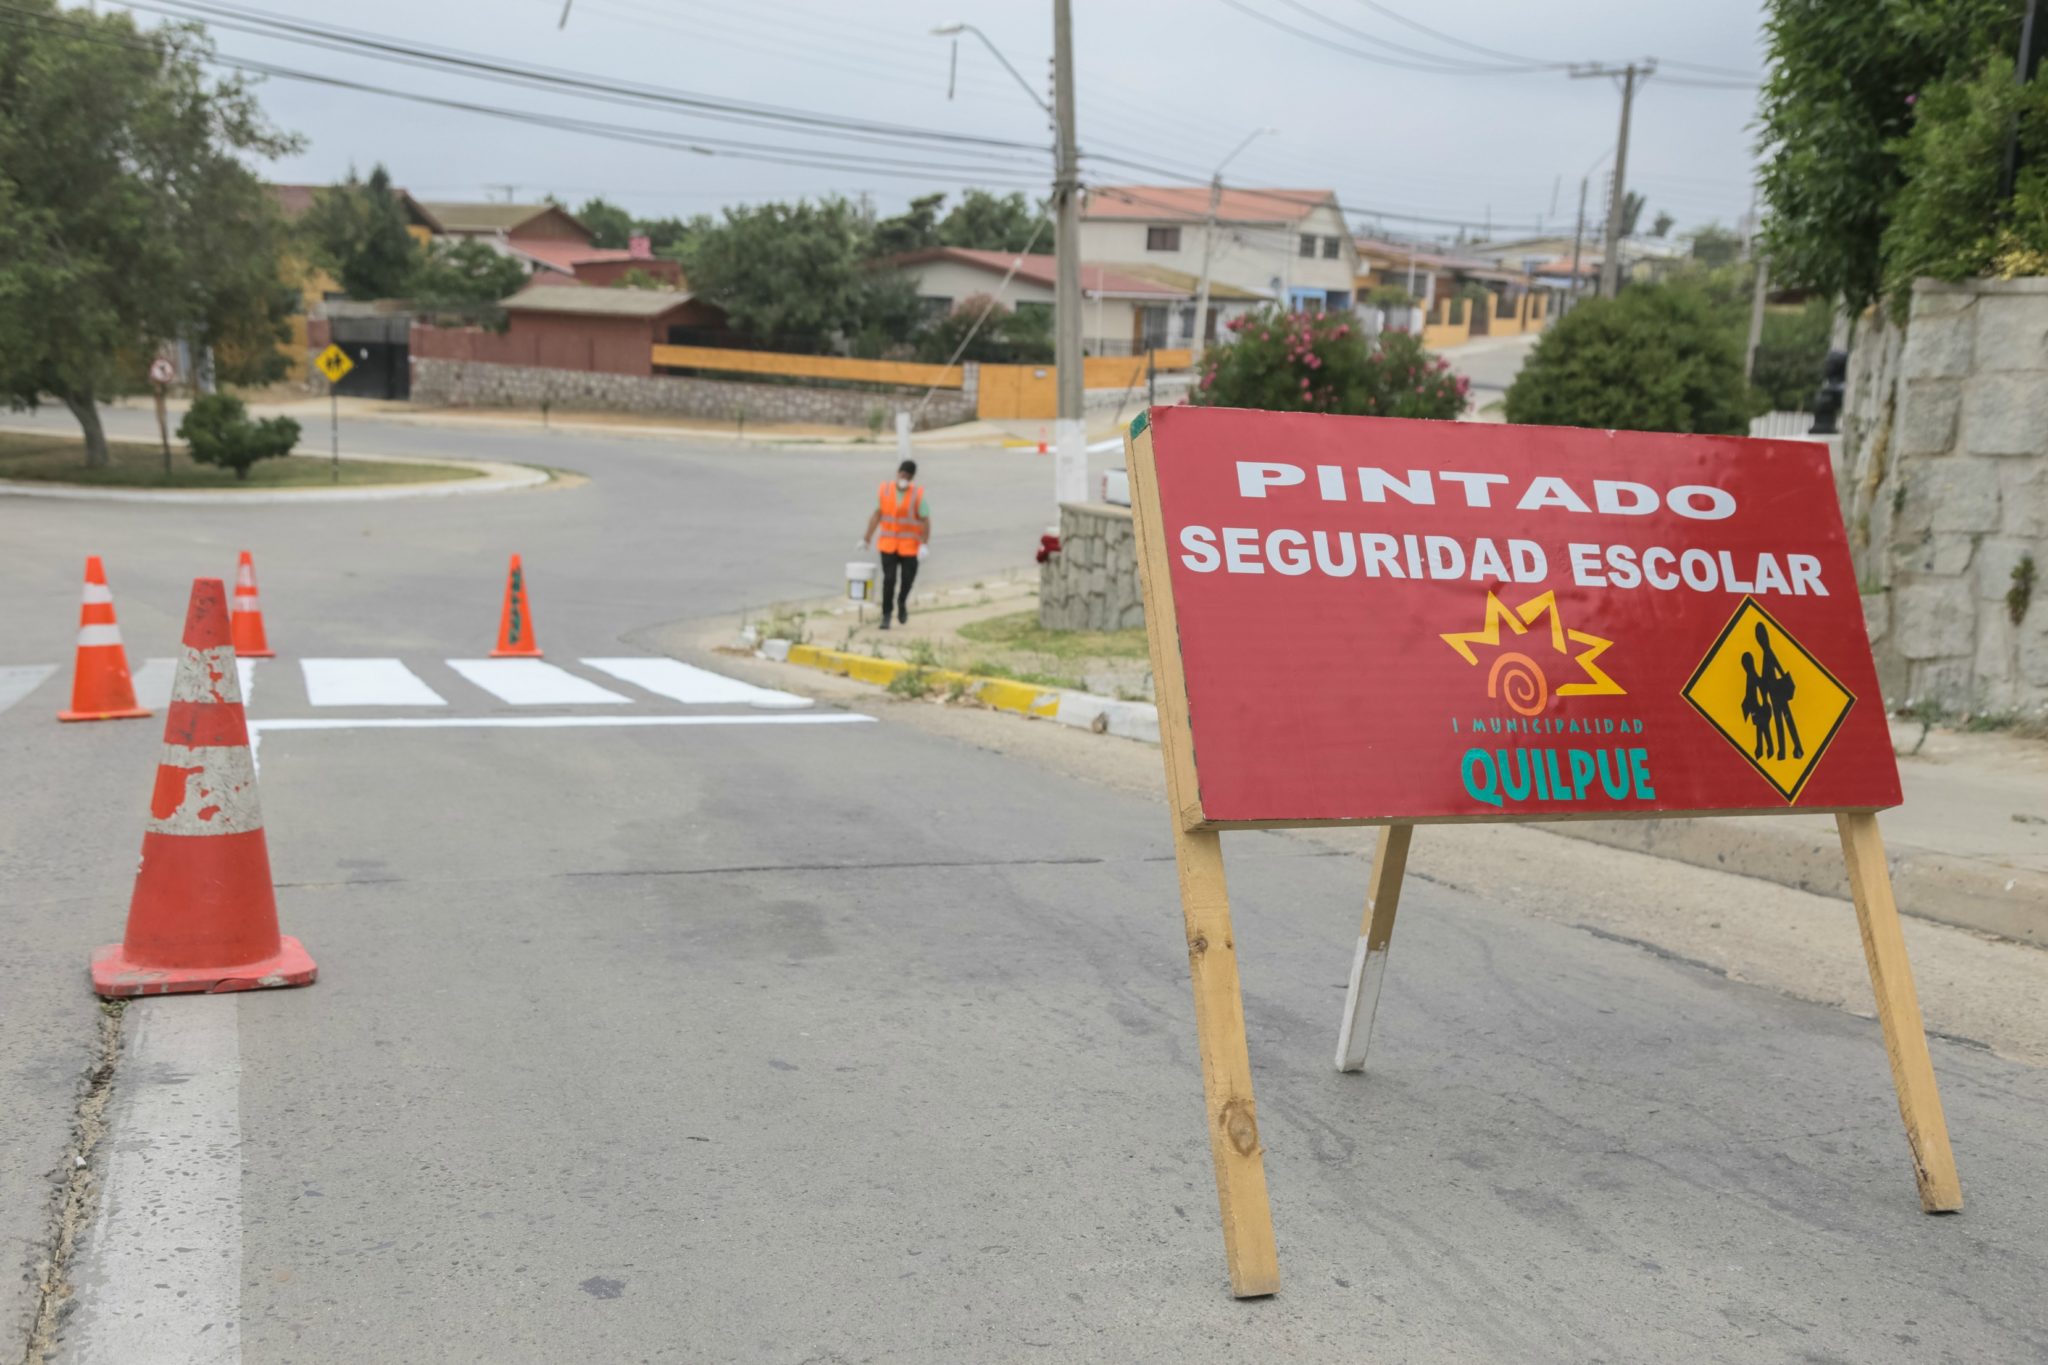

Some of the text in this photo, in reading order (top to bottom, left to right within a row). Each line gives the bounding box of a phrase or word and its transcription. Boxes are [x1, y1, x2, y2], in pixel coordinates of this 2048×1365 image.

[1236, 461, 1737, 520] PINTADO
[1180, 525, 1830, 597] SEGURIDAD ESCOLAR
[1472, 718, 1643, 734] MUNICIPALIDAD
[1461, 747, 1656, 808] QUILPUE
